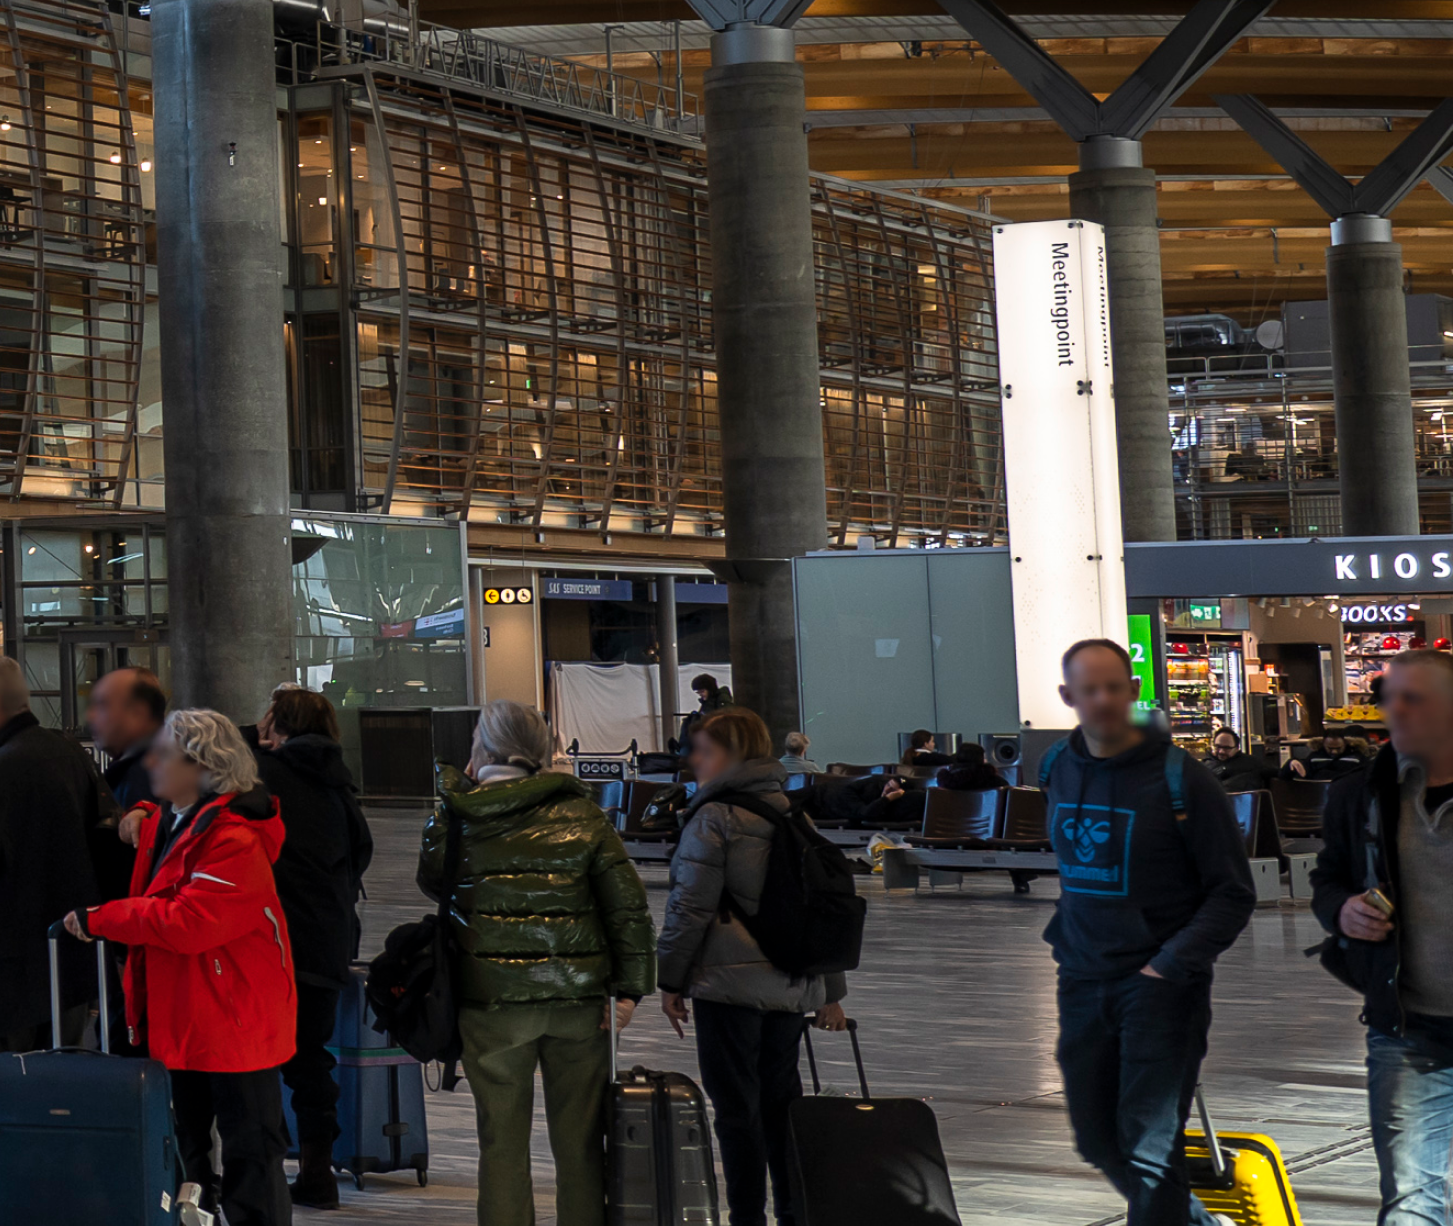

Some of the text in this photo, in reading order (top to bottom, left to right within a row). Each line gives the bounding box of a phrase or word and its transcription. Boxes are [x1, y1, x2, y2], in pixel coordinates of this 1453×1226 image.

[1050, 243, 1075, 366] Meetingpoint
[548, 583, 601, 595] SAS SERVICE POINT
